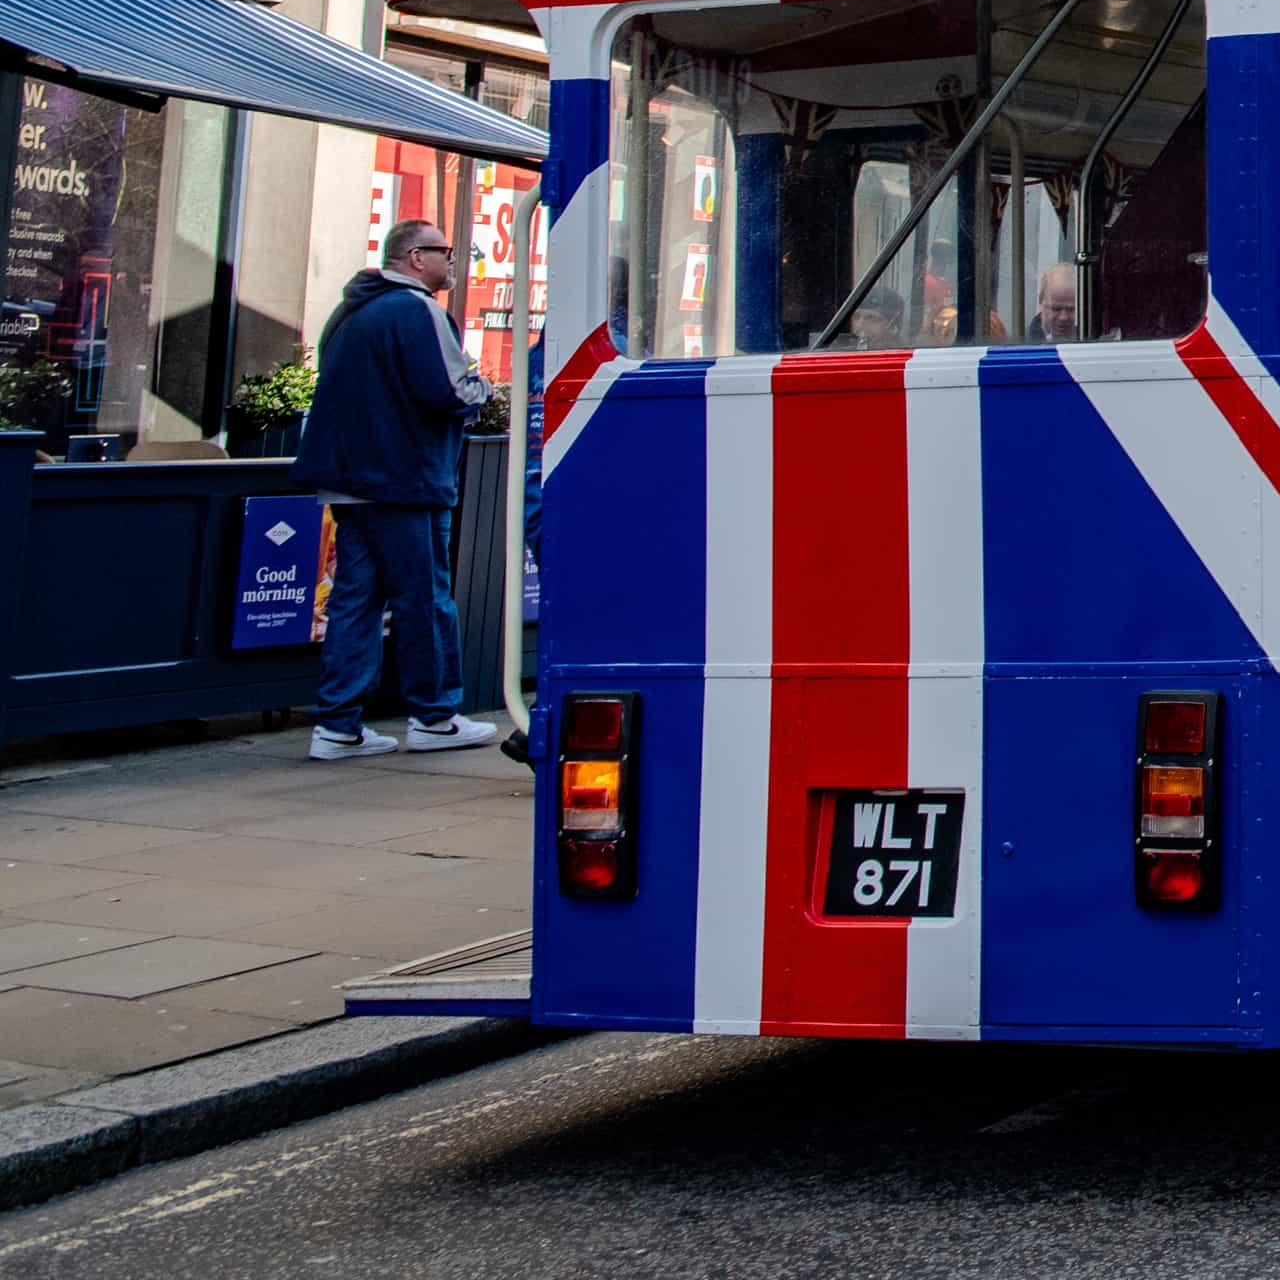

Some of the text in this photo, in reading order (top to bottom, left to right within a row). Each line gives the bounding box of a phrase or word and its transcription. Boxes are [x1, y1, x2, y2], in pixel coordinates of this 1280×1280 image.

[255, 565, 297, 584] Good
[853, 802, 948, 850] WLT
[853, 859, 933, 908] 871
